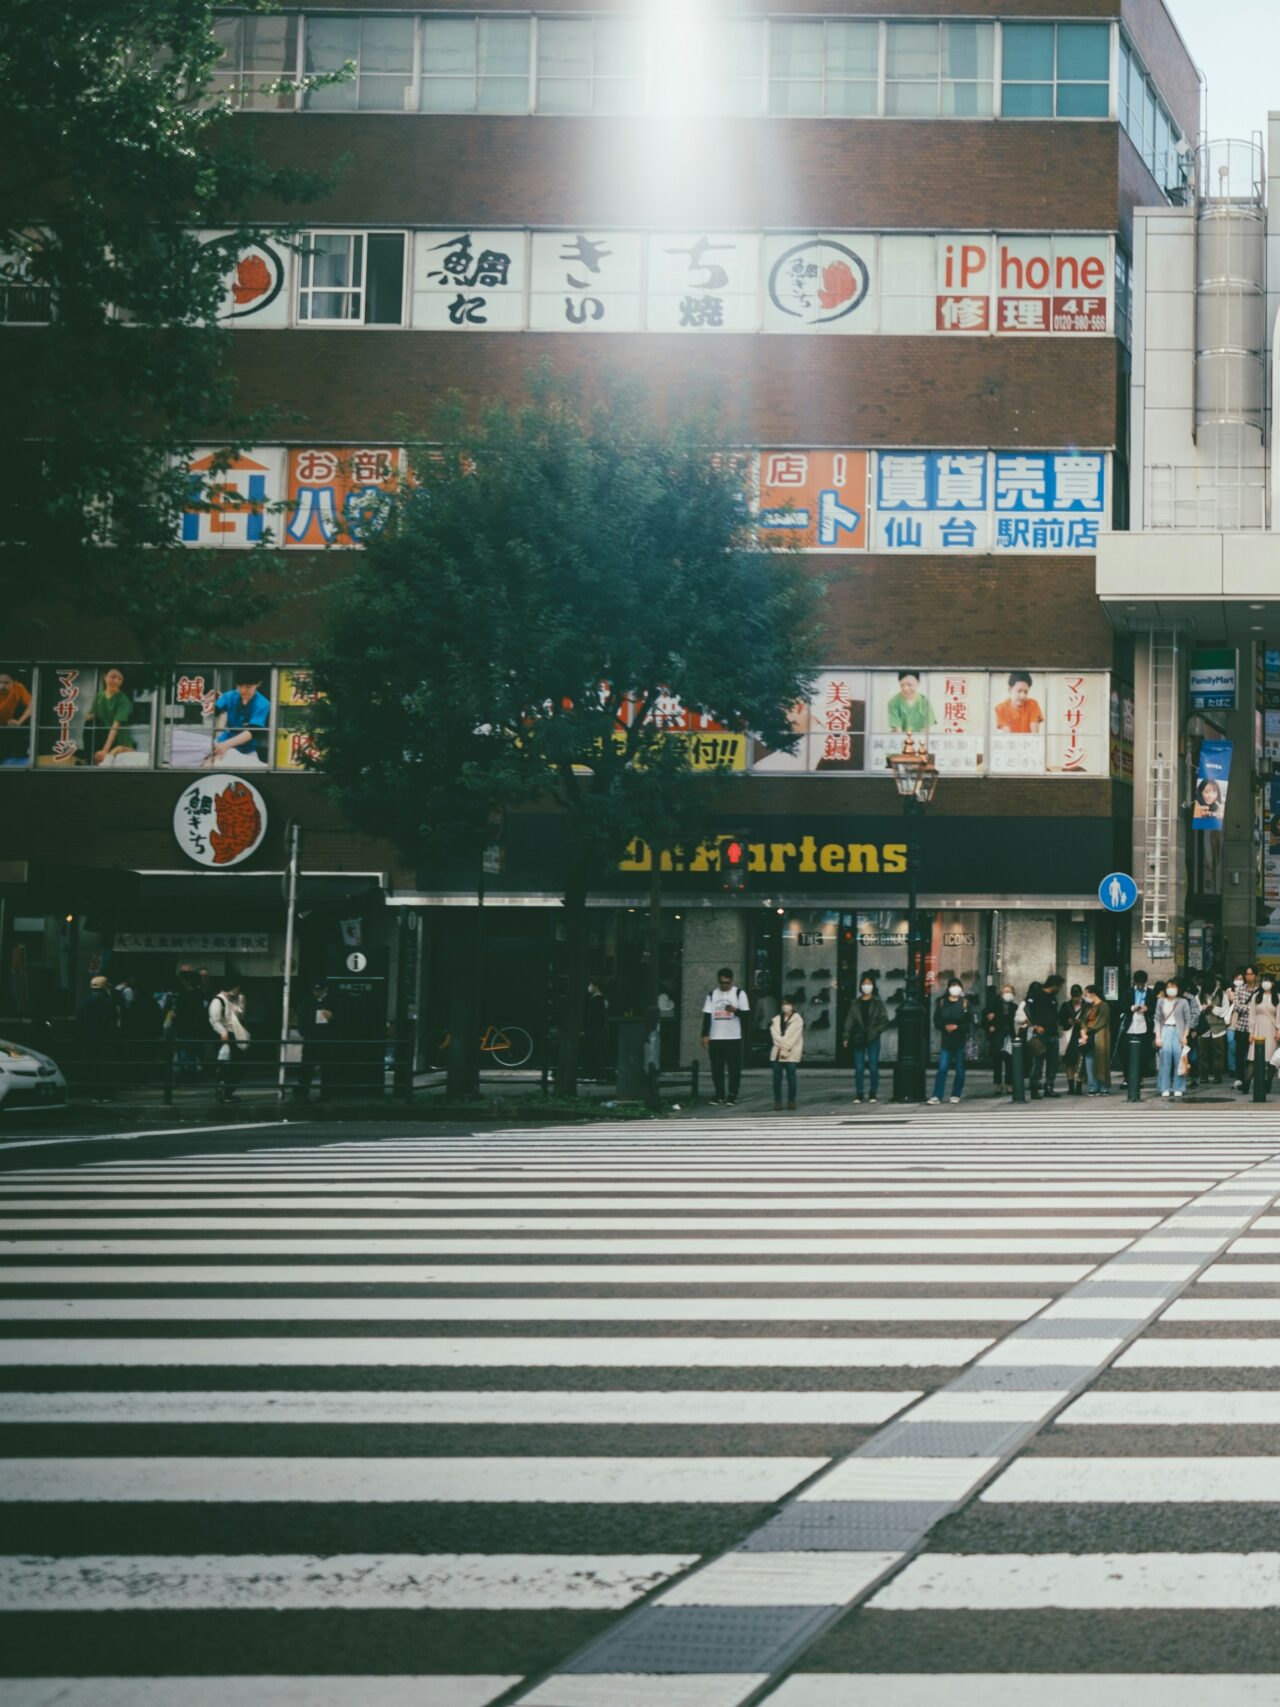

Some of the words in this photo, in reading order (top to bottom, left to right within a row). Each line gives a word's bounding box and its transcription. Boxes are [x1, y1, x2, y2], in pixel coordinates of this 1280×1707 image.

[944, 244, 1106, 291] iPhone
[941, 297, 1047, 331] 修理
[1061, 298, 1100, 315] 4F
[879, 454, 1104, 509] 賃貸売買
[1190, 675, 1234, 686] FamilyMart
[52, 668, 79, 763] マッサージ
[825, 680, 852, 761] 美容鍼
[1062, 676, 1088, 768] マッサージ
[1207, 697, 1232, 708] たばこ
[800, 934, 821, 946] THE
[944, 933, 974, 946] ICONS
